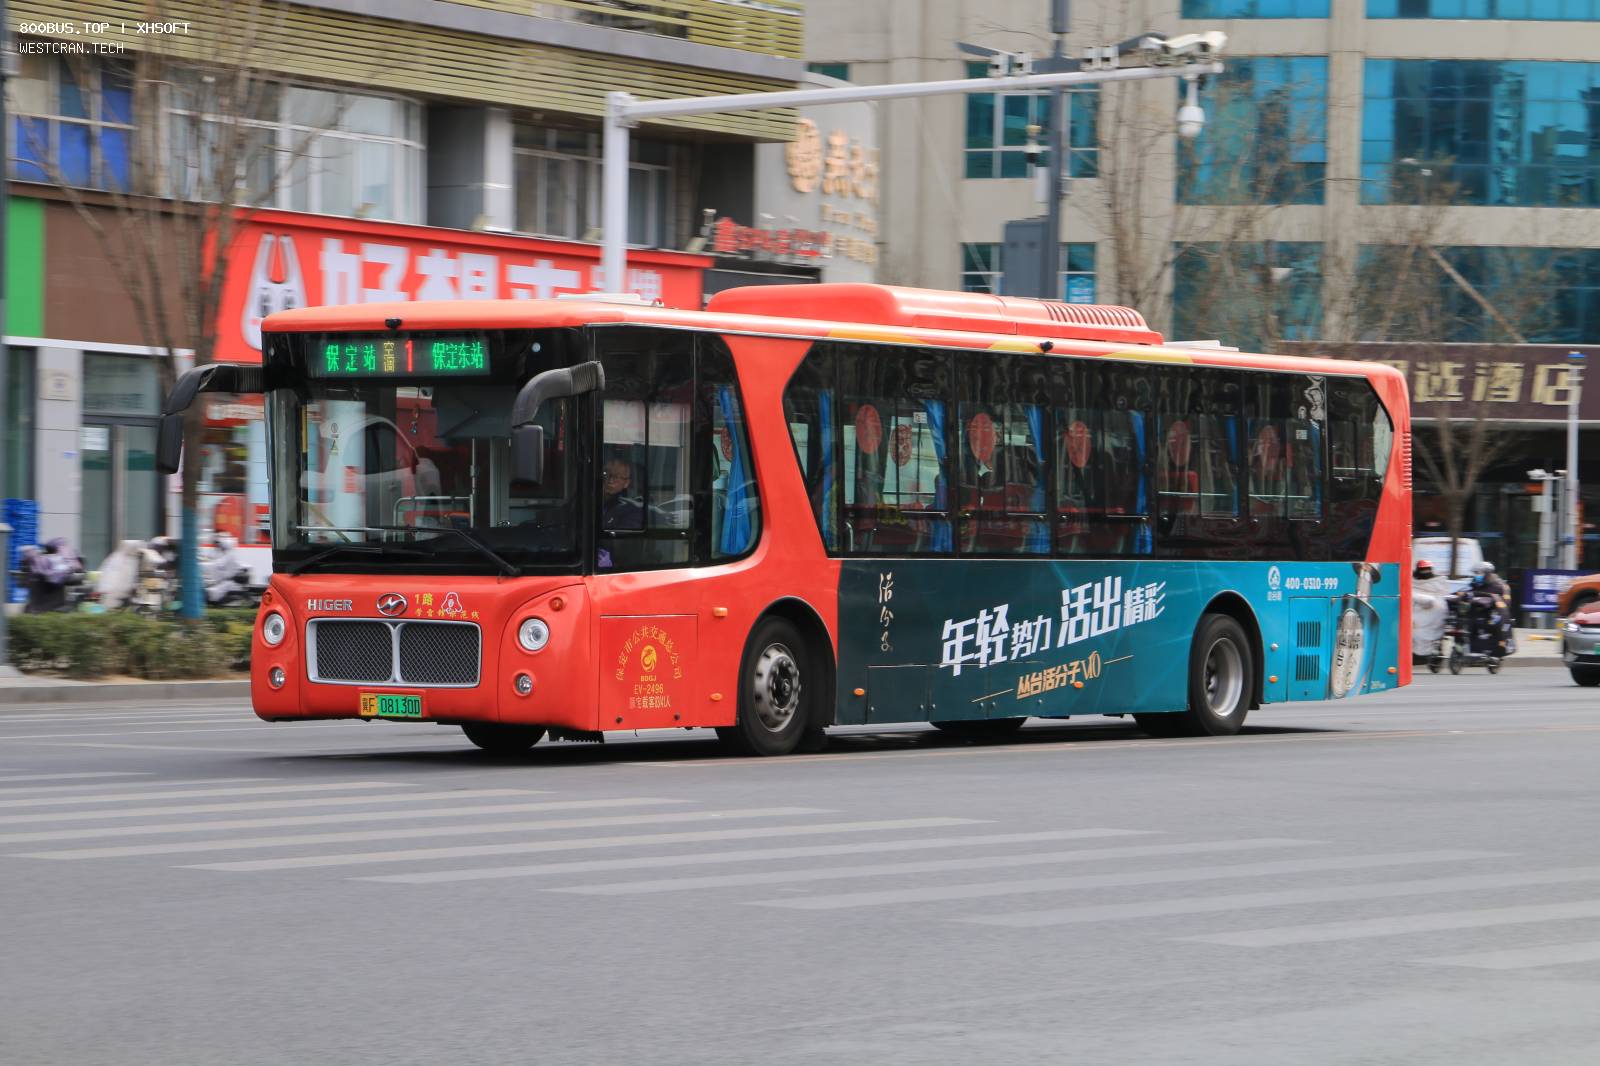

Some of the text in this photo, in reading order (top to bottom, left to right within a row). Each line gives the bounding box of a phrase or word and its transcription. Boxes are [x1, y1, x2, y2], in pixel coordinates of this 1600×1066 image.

[326, 344, 376, 372] 保定站
[405, 340, 413, 372] 1
[432, 342, 483, 370] 保定东站
[1285, 577, 1338, 590] 400-0310-999
[307, 599, 353, 611] HIGER
[939, 576, 1166, 677] 年轻势力 活出精彩
[634, 683, 664, 694] EV-2496
[380, 698, 420, 714] 08130D
